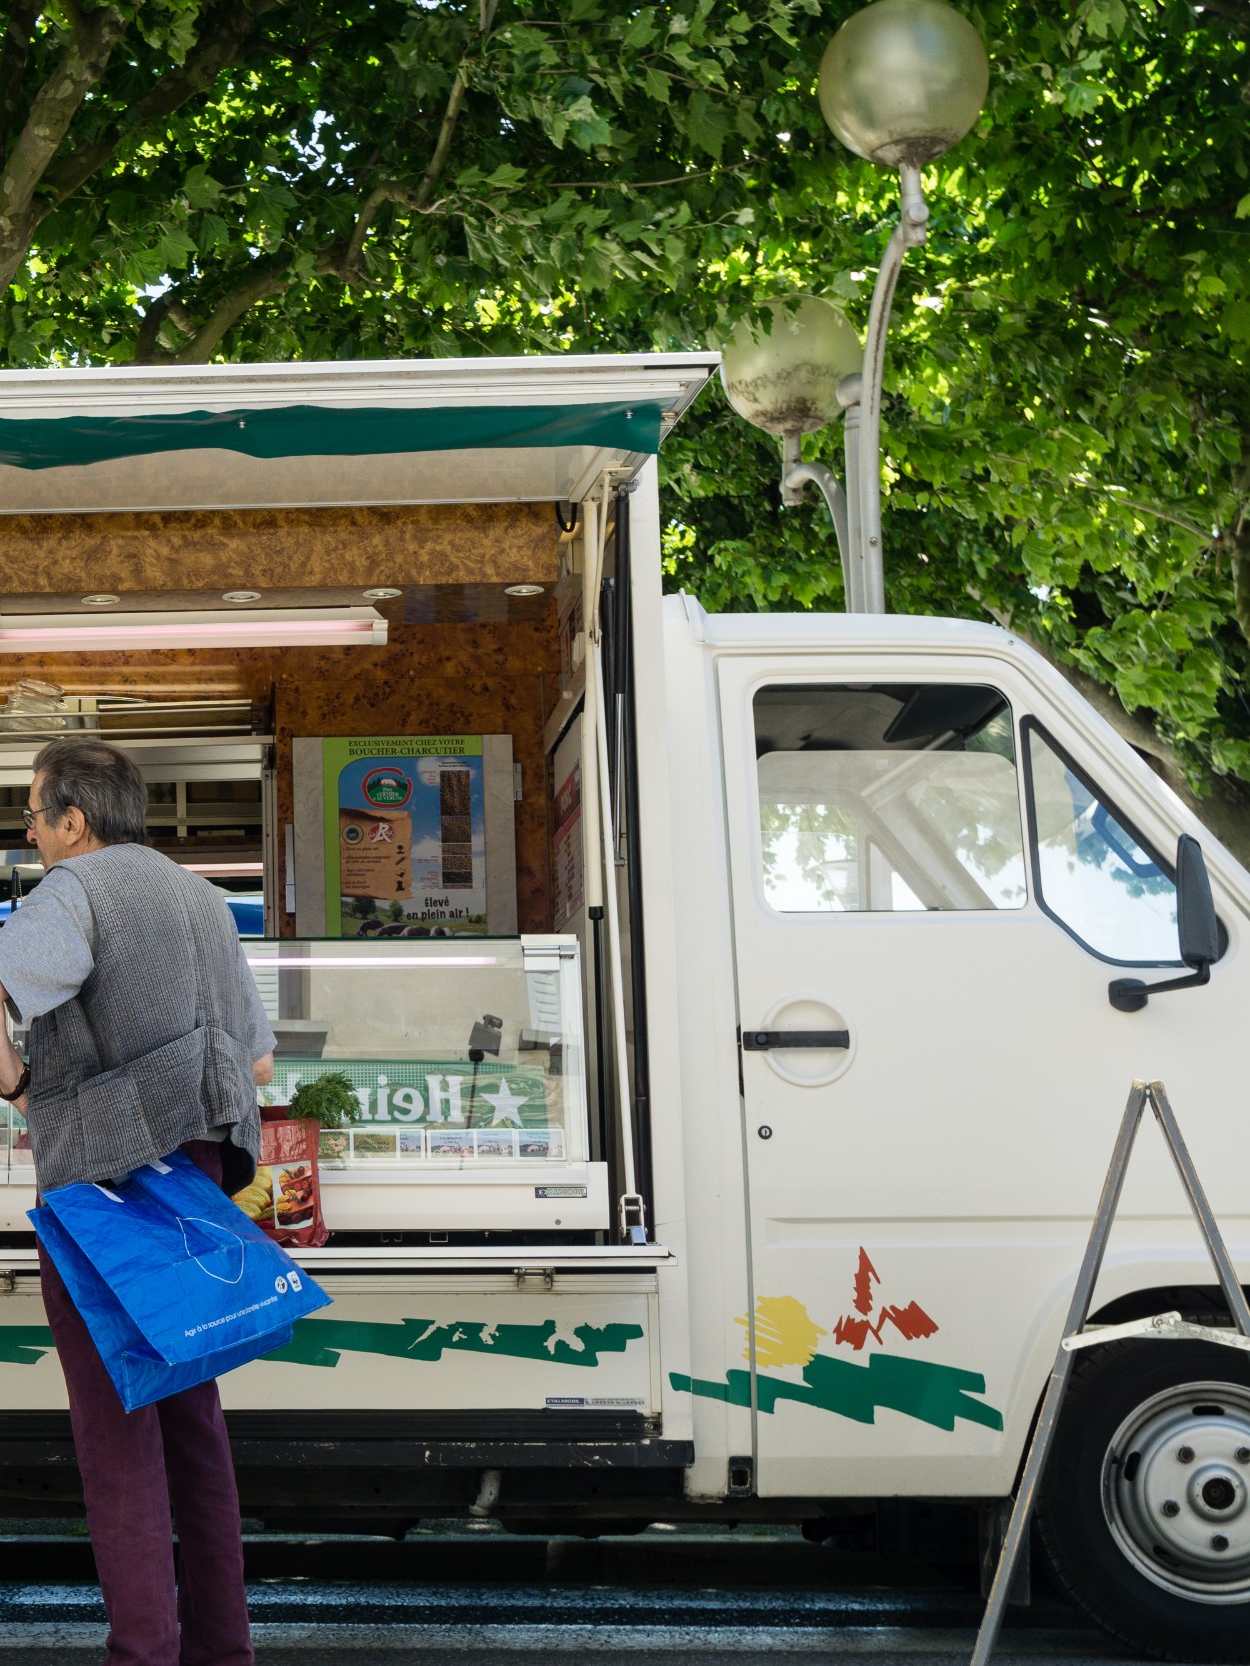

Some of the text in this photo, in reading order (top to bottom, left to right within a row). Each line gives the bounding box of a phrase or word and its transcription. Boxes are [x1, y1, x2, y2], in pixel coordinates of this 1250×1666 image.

[348, 739, 414, 747] EXCLUSIVEMENT
[415, 739, 437, 747] CHEZ
[349, 746, 466, 756] BOUCHER-CHARCUTIER
[406, 912, 419, 920] en
[421, 909, 446, 922] plein
[448, 908, 463, 919] air
[184, 1326, 197, 1338] Agir
[207, 1317, 226, 1328] source
[225, 1312, 237, 1323] pour
[259, 1295, 278, 1307] vivante
